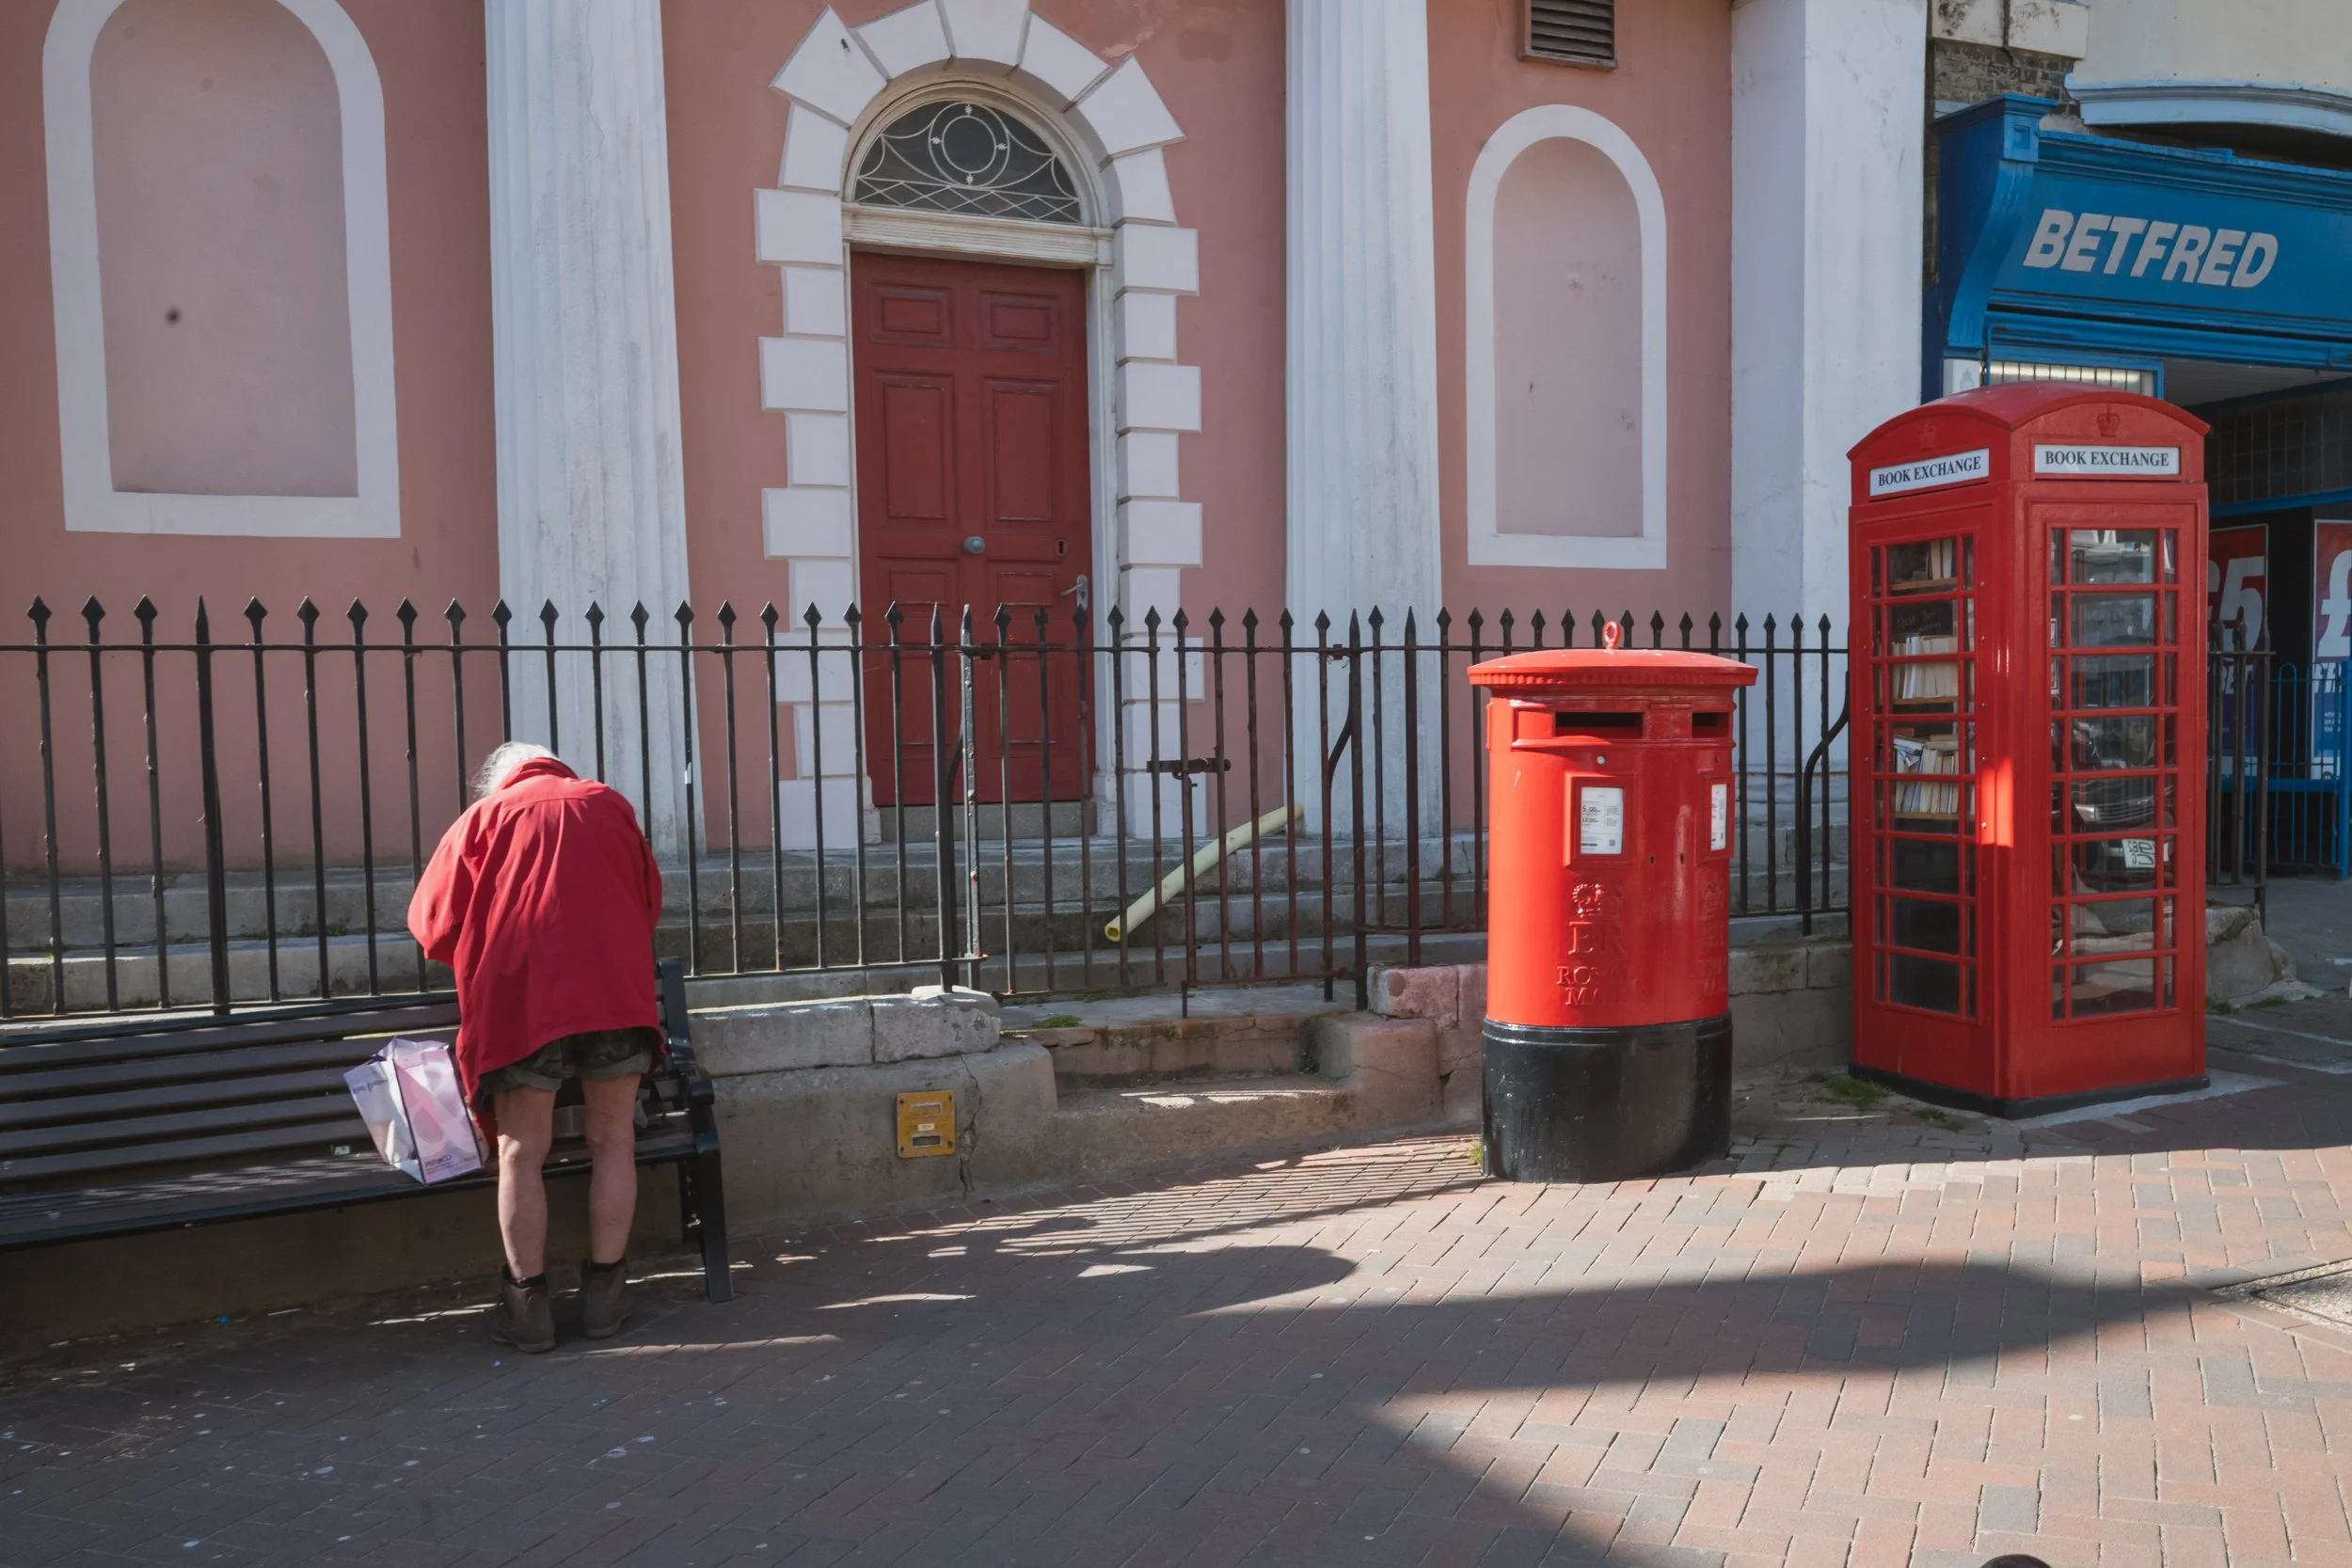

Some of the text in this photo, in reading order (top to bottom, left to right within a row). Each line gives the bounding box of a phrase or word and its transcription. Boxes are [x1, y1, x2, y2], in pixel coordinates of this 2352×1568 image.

[2024, 208, 2278, 288] BETFRED
[1878, 455, 1981, 487] BOOK EXCHANGE
[2044, 451, 2169, 467] BOOK EXCHANGE
